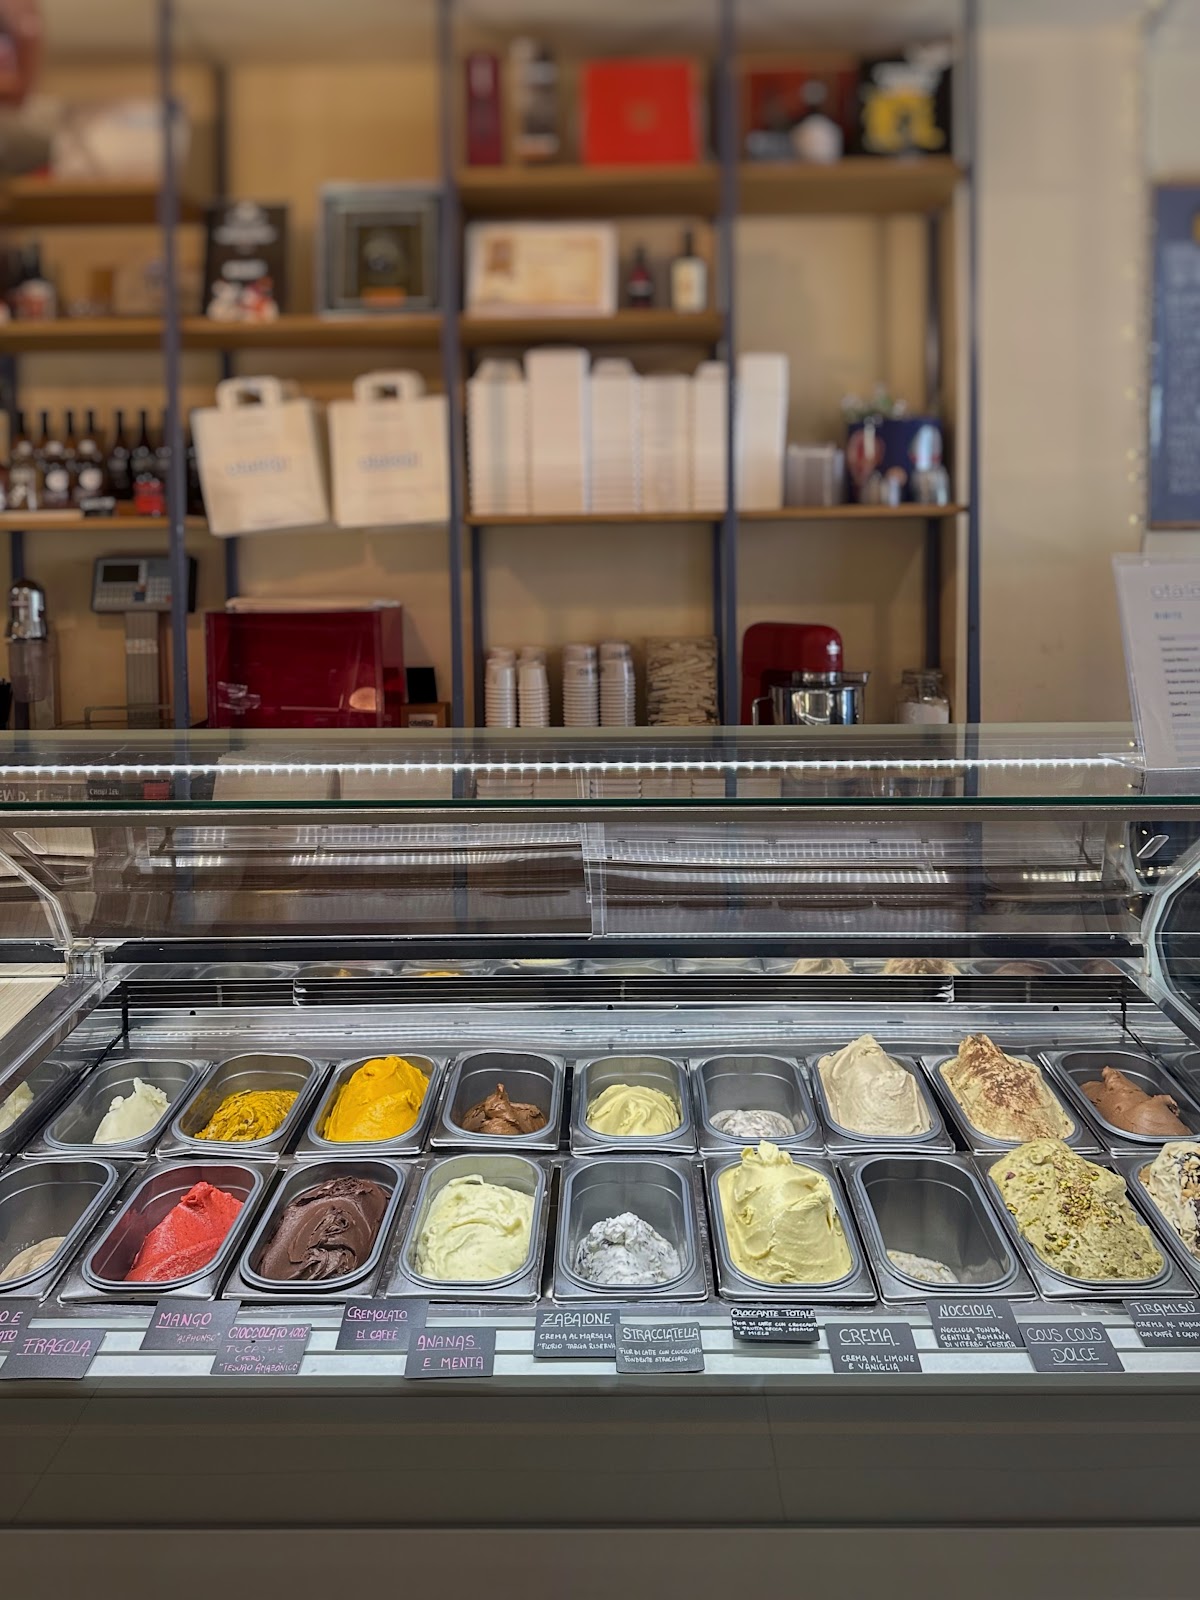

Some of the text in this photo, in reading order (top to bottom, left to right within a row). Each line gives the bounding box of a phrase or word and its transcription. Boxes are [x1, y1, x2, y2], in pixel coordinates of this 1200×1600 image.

[347, 1306, 408, 1321] CREMOLATO
[731, 1308, 815, 1318] CROCCANTE TOTALE
[940, 1304, 996, 1317] NOCCIOLA
[1130, 1301, 1196, 1316] TIRAMISÙ
[11, 1311, 24, 1322] E
[158, 1312, 212, 1327] MANGO
[542, 1312, 612, 1327] ZABAIONE
[228, 1326, 287, 1340] CIOCCOLATO
[540, 1333, 567, 1341] CREMA
[622, 1327, 699, 1342] STRACCIATELLA
[839, 1329, 895, 1346] CREMA
[1026, 1327, 1103, 1342] COUS COUS
[23, 1337, 91, 1357] FRAGOLA
[417, 1335, 475, 1351] ANANAS
[423, 1356, 484, 1370] E MENTA
[841, 1355, 915, 1363] CREMA AL LIMONE
[1050, 1348, 1100, 1363] DOLCE
[859, 1363, 900, 1372] VANIGLIA
